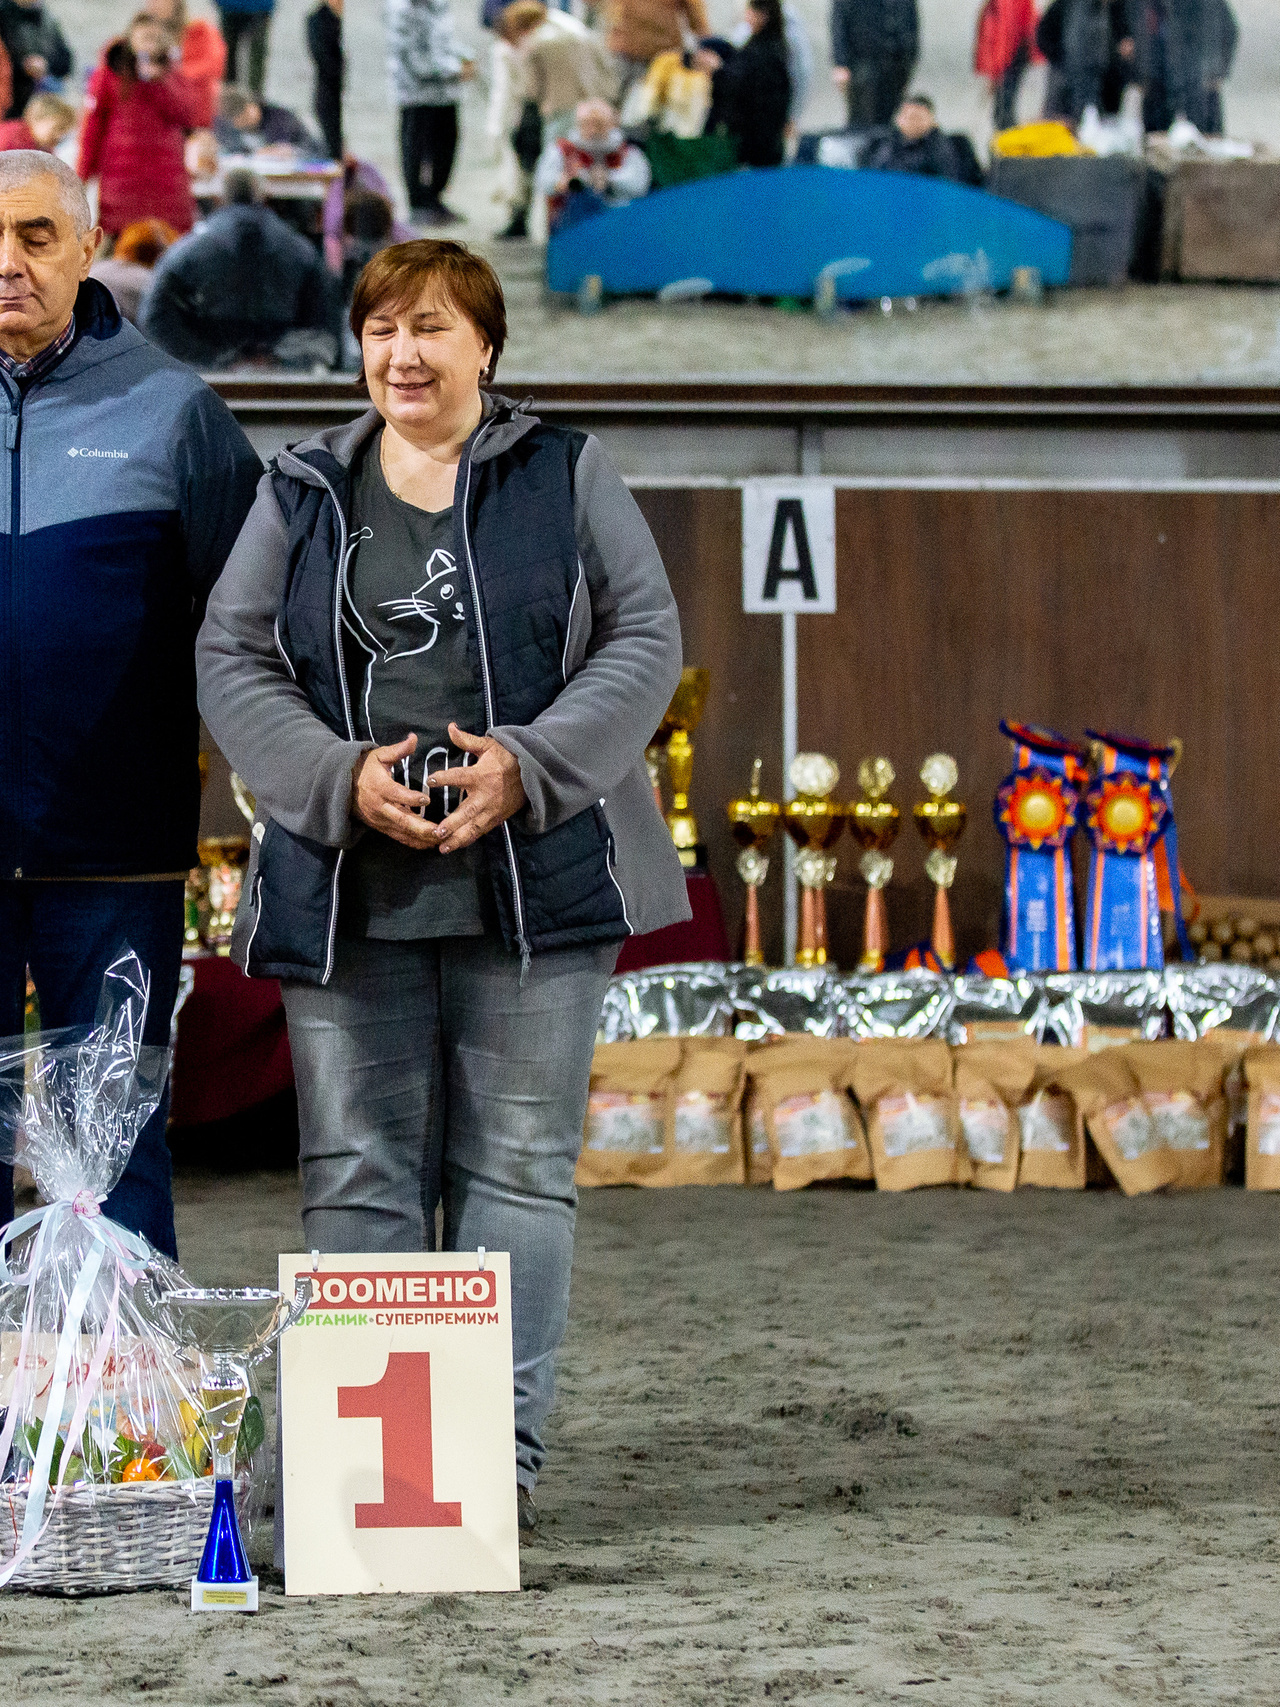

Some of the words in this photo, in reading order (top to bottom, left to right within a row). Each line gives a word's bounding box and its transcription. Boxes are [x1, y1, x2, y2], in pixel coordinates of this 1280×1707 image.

[79, 448, 129, 459] Columbia
[762, 498, 818, 600] A
[375, 1312, 499, 1326] СУПЕРПРЕМИУМ
[337, 1351, 463, 1529] 1
